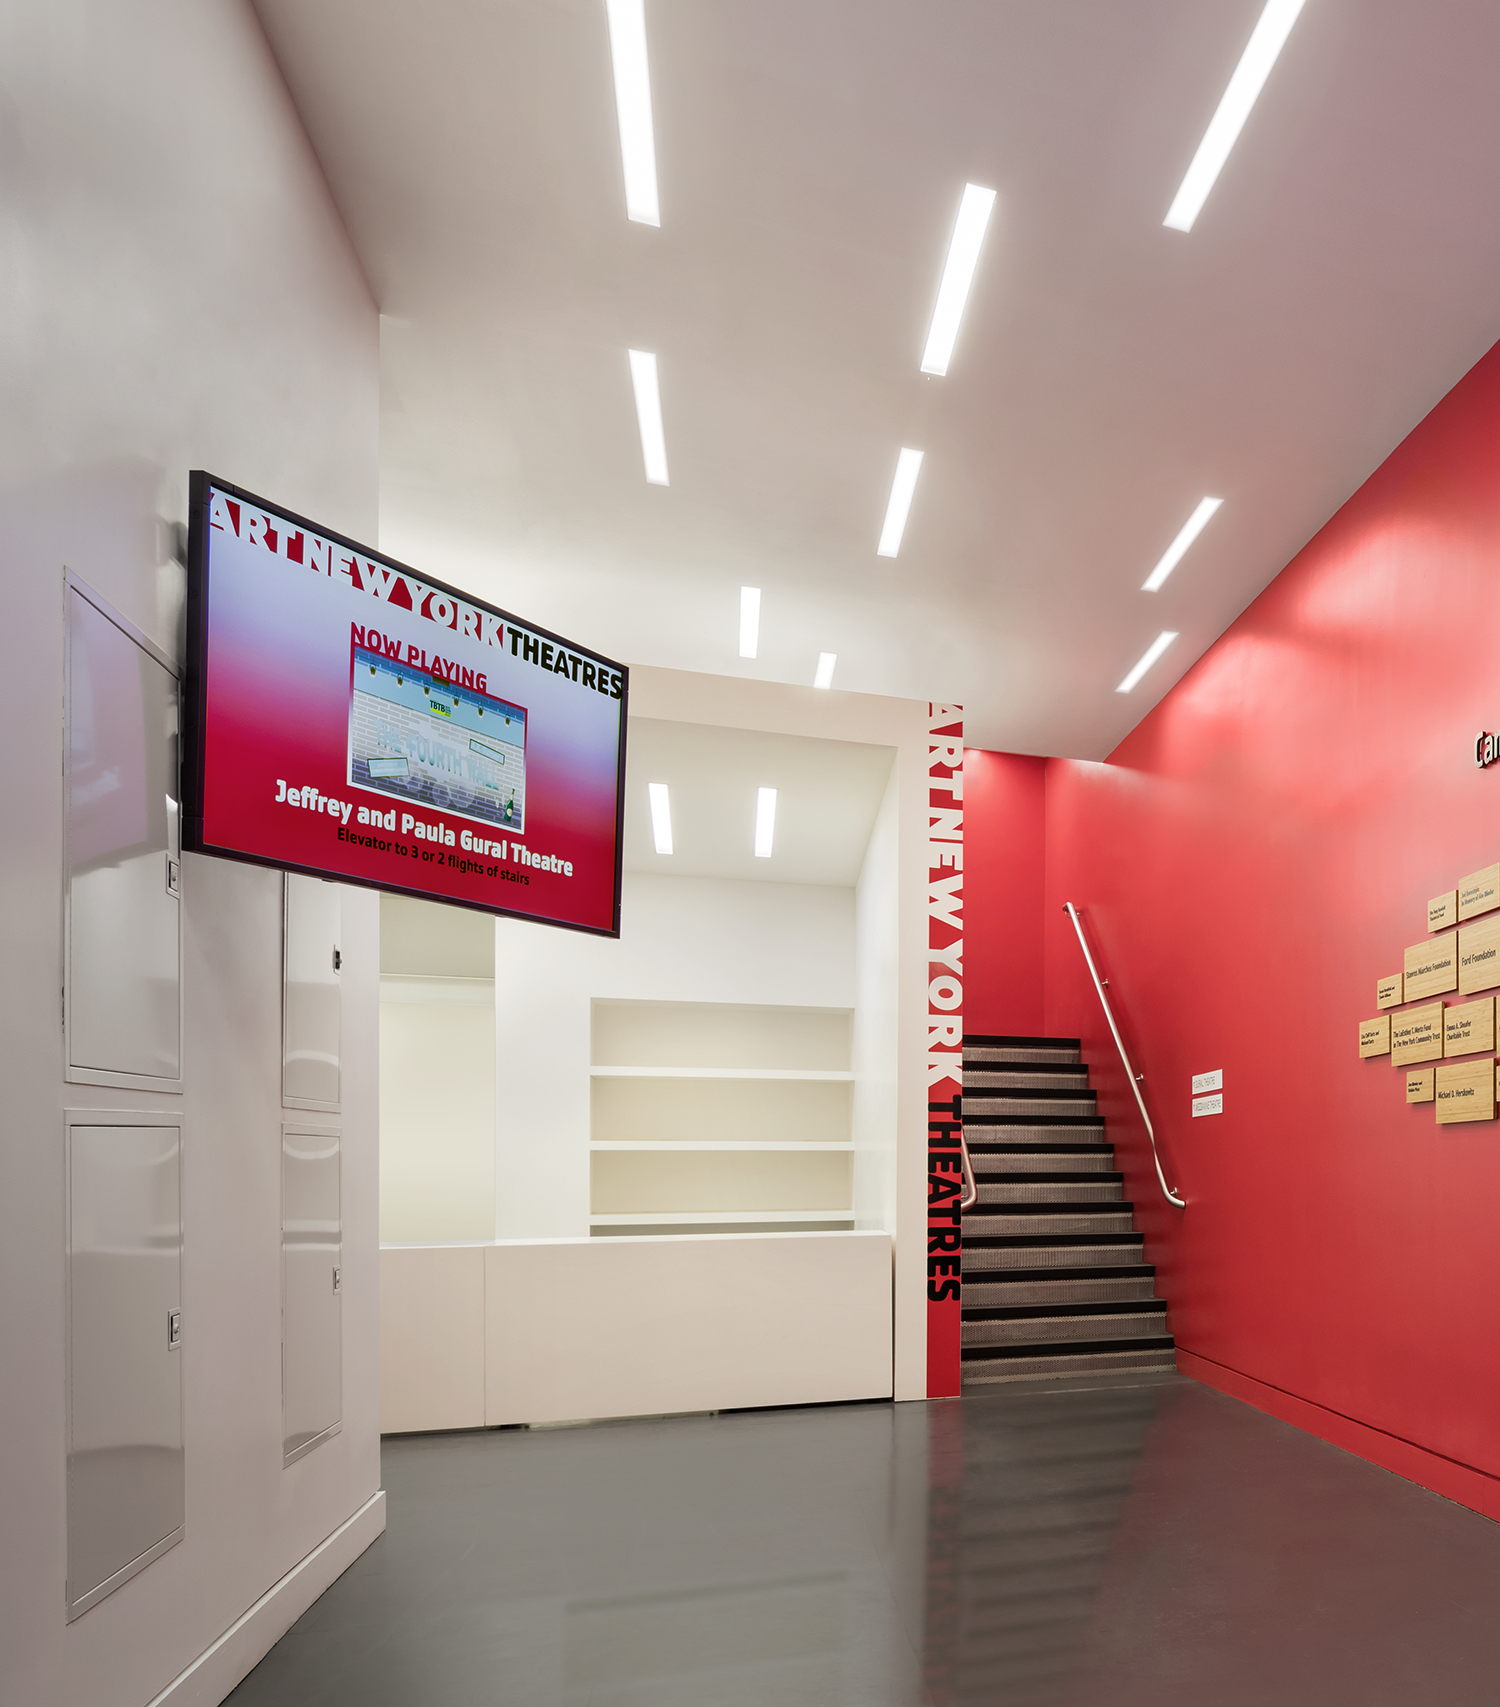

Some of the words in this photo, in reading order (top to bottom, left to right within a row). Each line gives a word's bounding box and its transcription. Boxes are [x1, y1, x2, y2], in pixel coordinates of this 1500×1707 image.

[303, 530, 399, 599] NEW
[403, 577, 503, 649] YORK
[507, 626, 623, 700] THEATRES
[352, 622, 402, 661] NOW
[408, 644, 487, 694] PLAYING
[373, 718, 402, 753] THE
[406, 732, 462, 776] FOURTH
[275, 779, 353, 825] Jeffrey
[357, 804, 396, 831] and
[402, 813, 455, 846] Paula
[461, 831, 507, 860] Gural
[511, 842, 573, 876] Theatre
[337, 827, 392, 852] Elevator
[395, 842, 408, 856] to
[411, 846, 419, 859] 3
[422, 851, 435, 862] or
[438, 852, 445, 865] 2
[448, 855, 484, 874] flights
[487, 865, 500, 877] of
[501, 868, 530, 885] stairs
[929, 808, 963, 933] NEW
[1461, 954, 1471, 966] Ford
[1471, 948, 1496, 963] Foundation
[928, 938, 963, 1087] YORK
[926, 1094, 962, 1302] THEATRES
